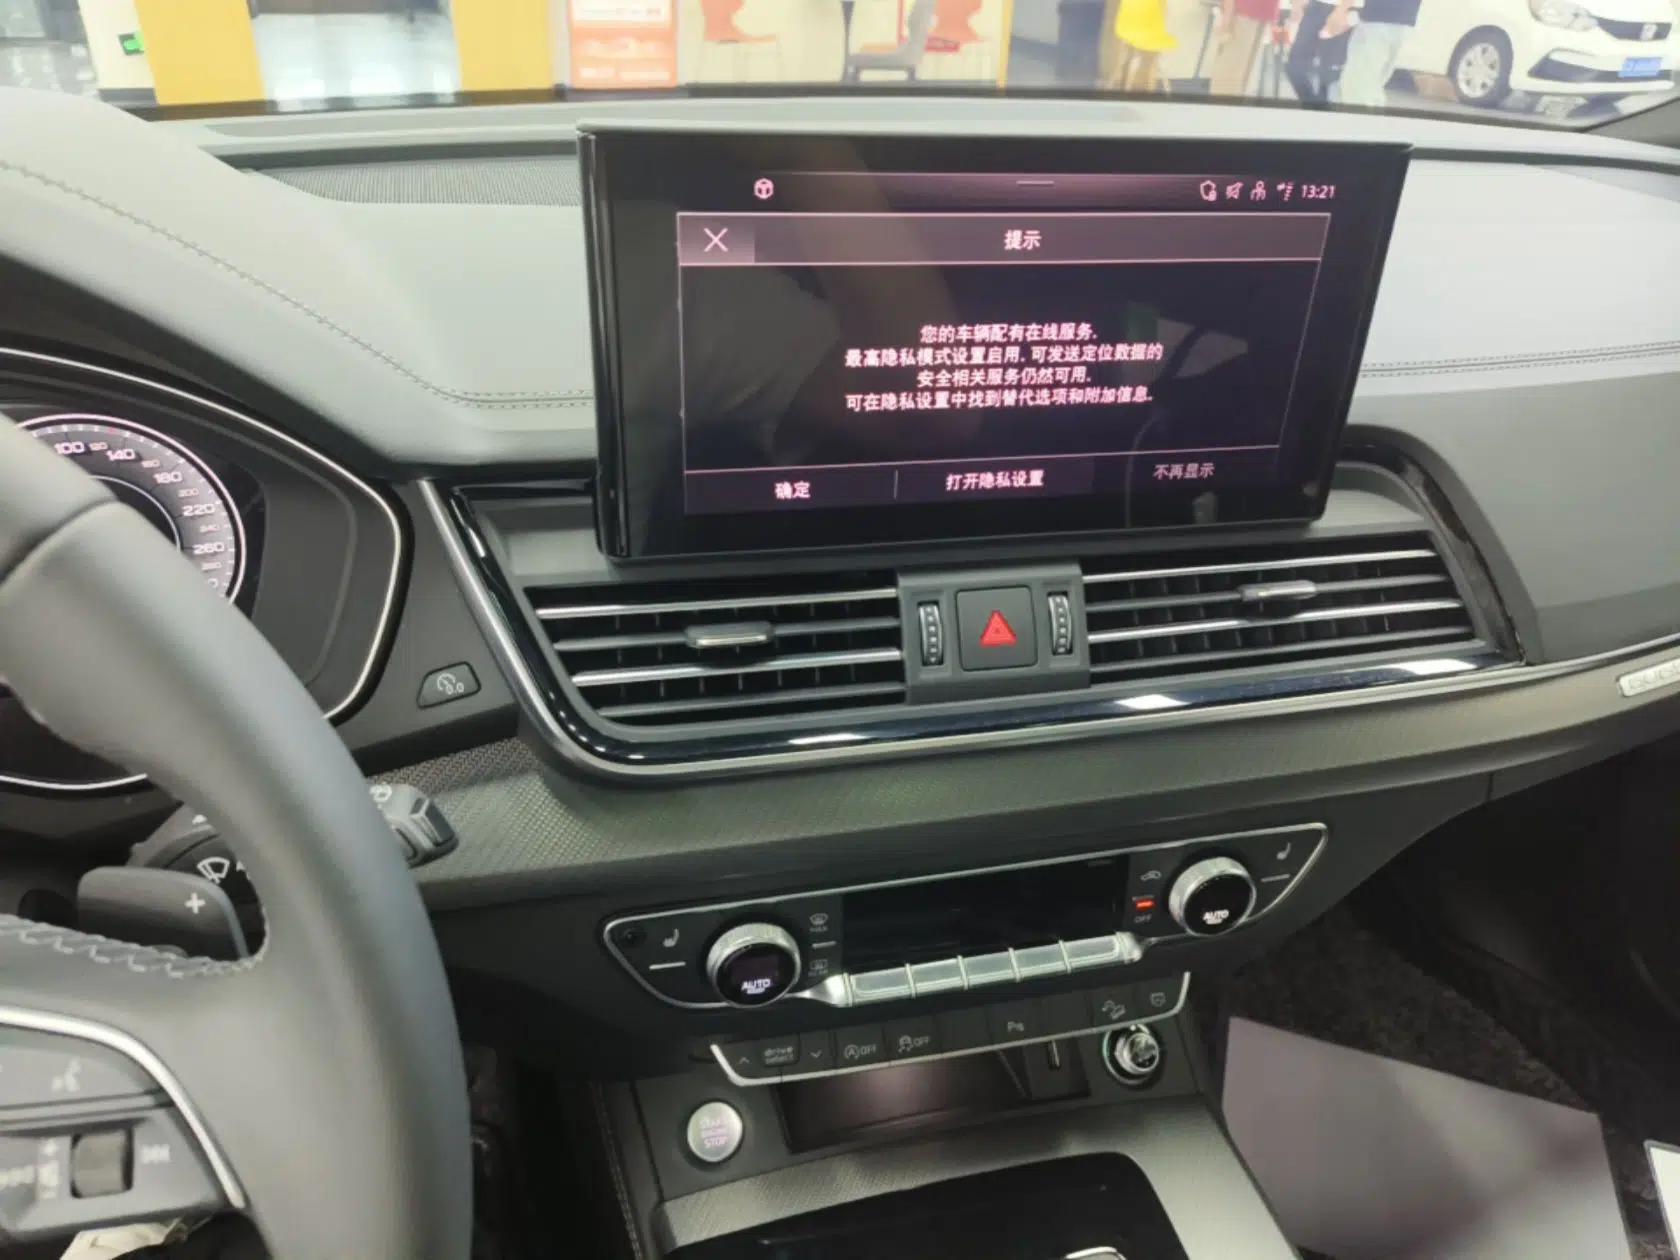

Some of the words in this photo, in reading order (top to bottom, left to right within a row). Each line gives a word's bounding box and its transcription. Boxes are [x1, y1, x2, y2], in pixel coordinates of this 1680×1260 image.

[1302, 184, 1335, 199] 13:21
[1004, 229, 1042, 250] 提示
[54, 441, 85, 455] 100
[106, 448, 135, 461] 140
[1153, 462, 1215, 480] 不再显示
[946, 470, 1045, 490] 打开隐私设置
[774, 481, 811, 499] 确定
[182, 503, 215, 517] 220
[1203, 909, 1229, 921] AUTO
[741, 979, 771, 991] AUTO
[913, 1036, 931, 1047] OFF
[860, 1044, 877, 1055] OFF
